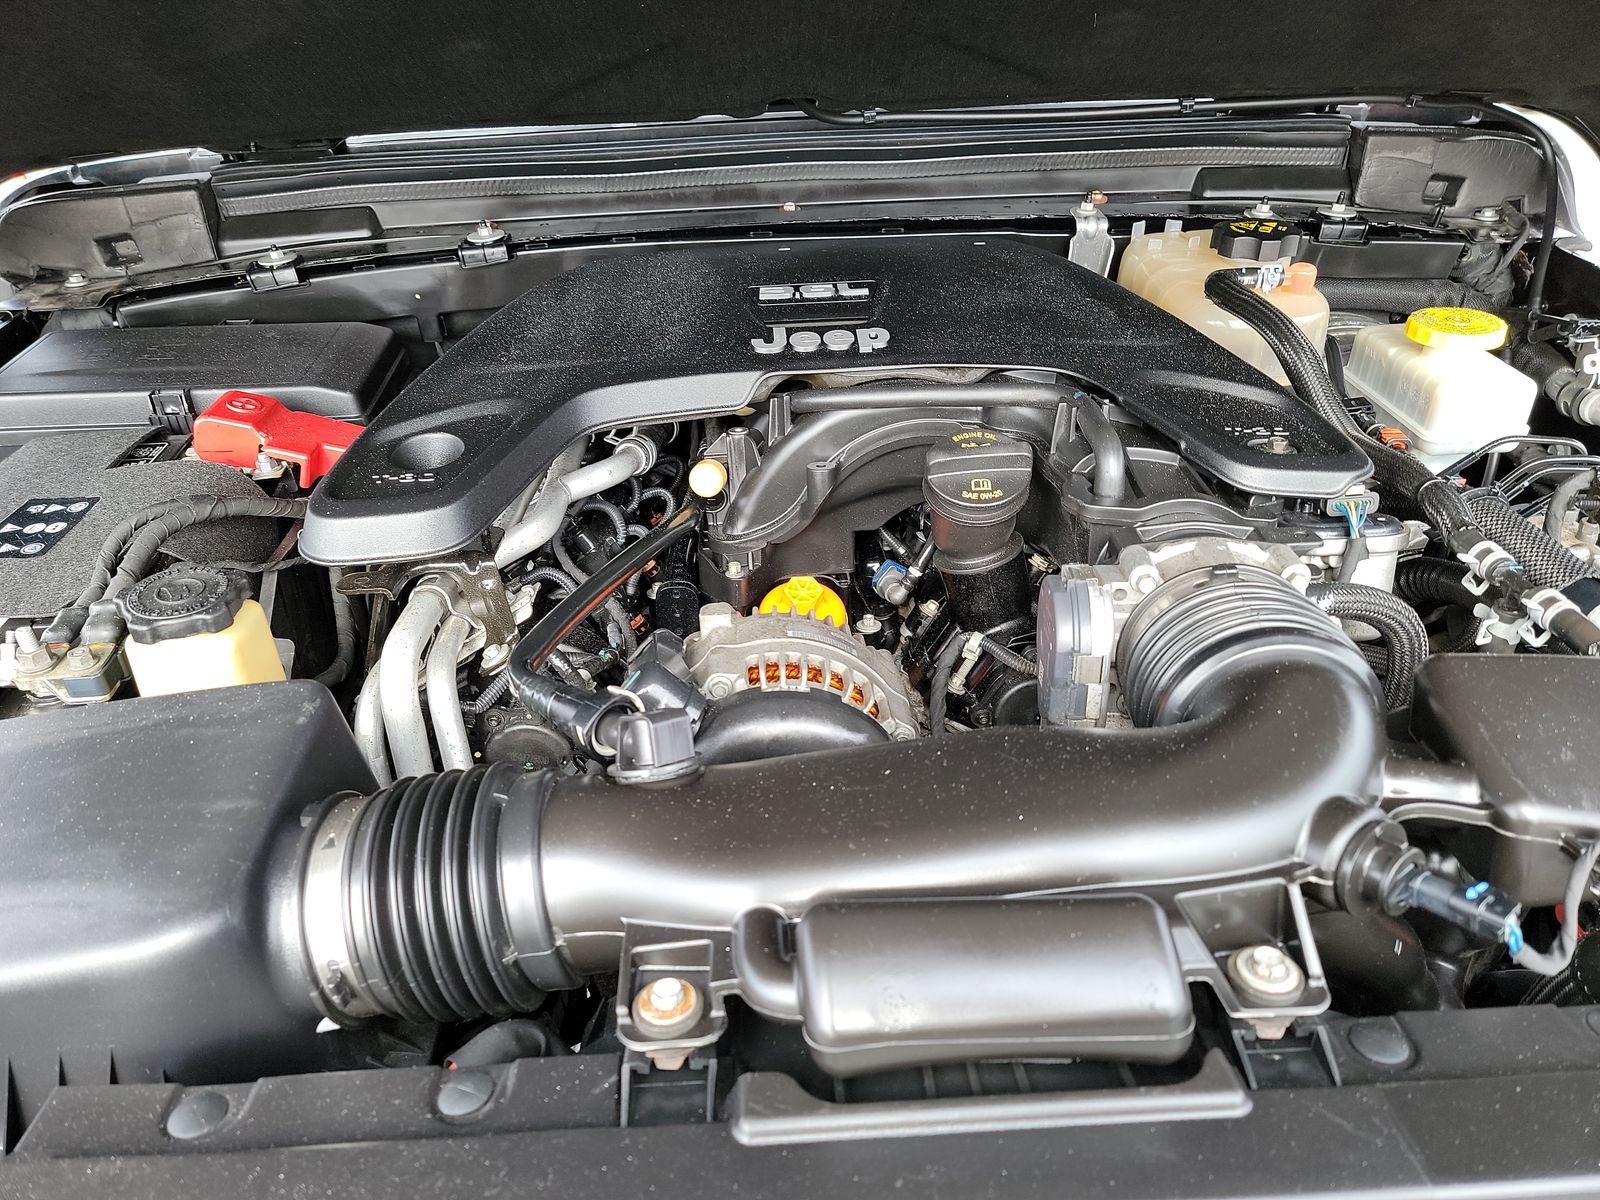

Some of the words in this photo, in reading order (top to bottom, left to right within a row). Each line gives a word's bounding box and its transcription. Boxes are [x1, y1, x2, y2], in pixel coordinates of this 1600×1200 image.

[751, 327, 890, 354] Jeep
[952, 431, 983, 442] ENGINE
[984, 432, 998, 441] OIL
[961, 490, 979, 500] SAE
[979, 489, 1004, 500] 0W-20
